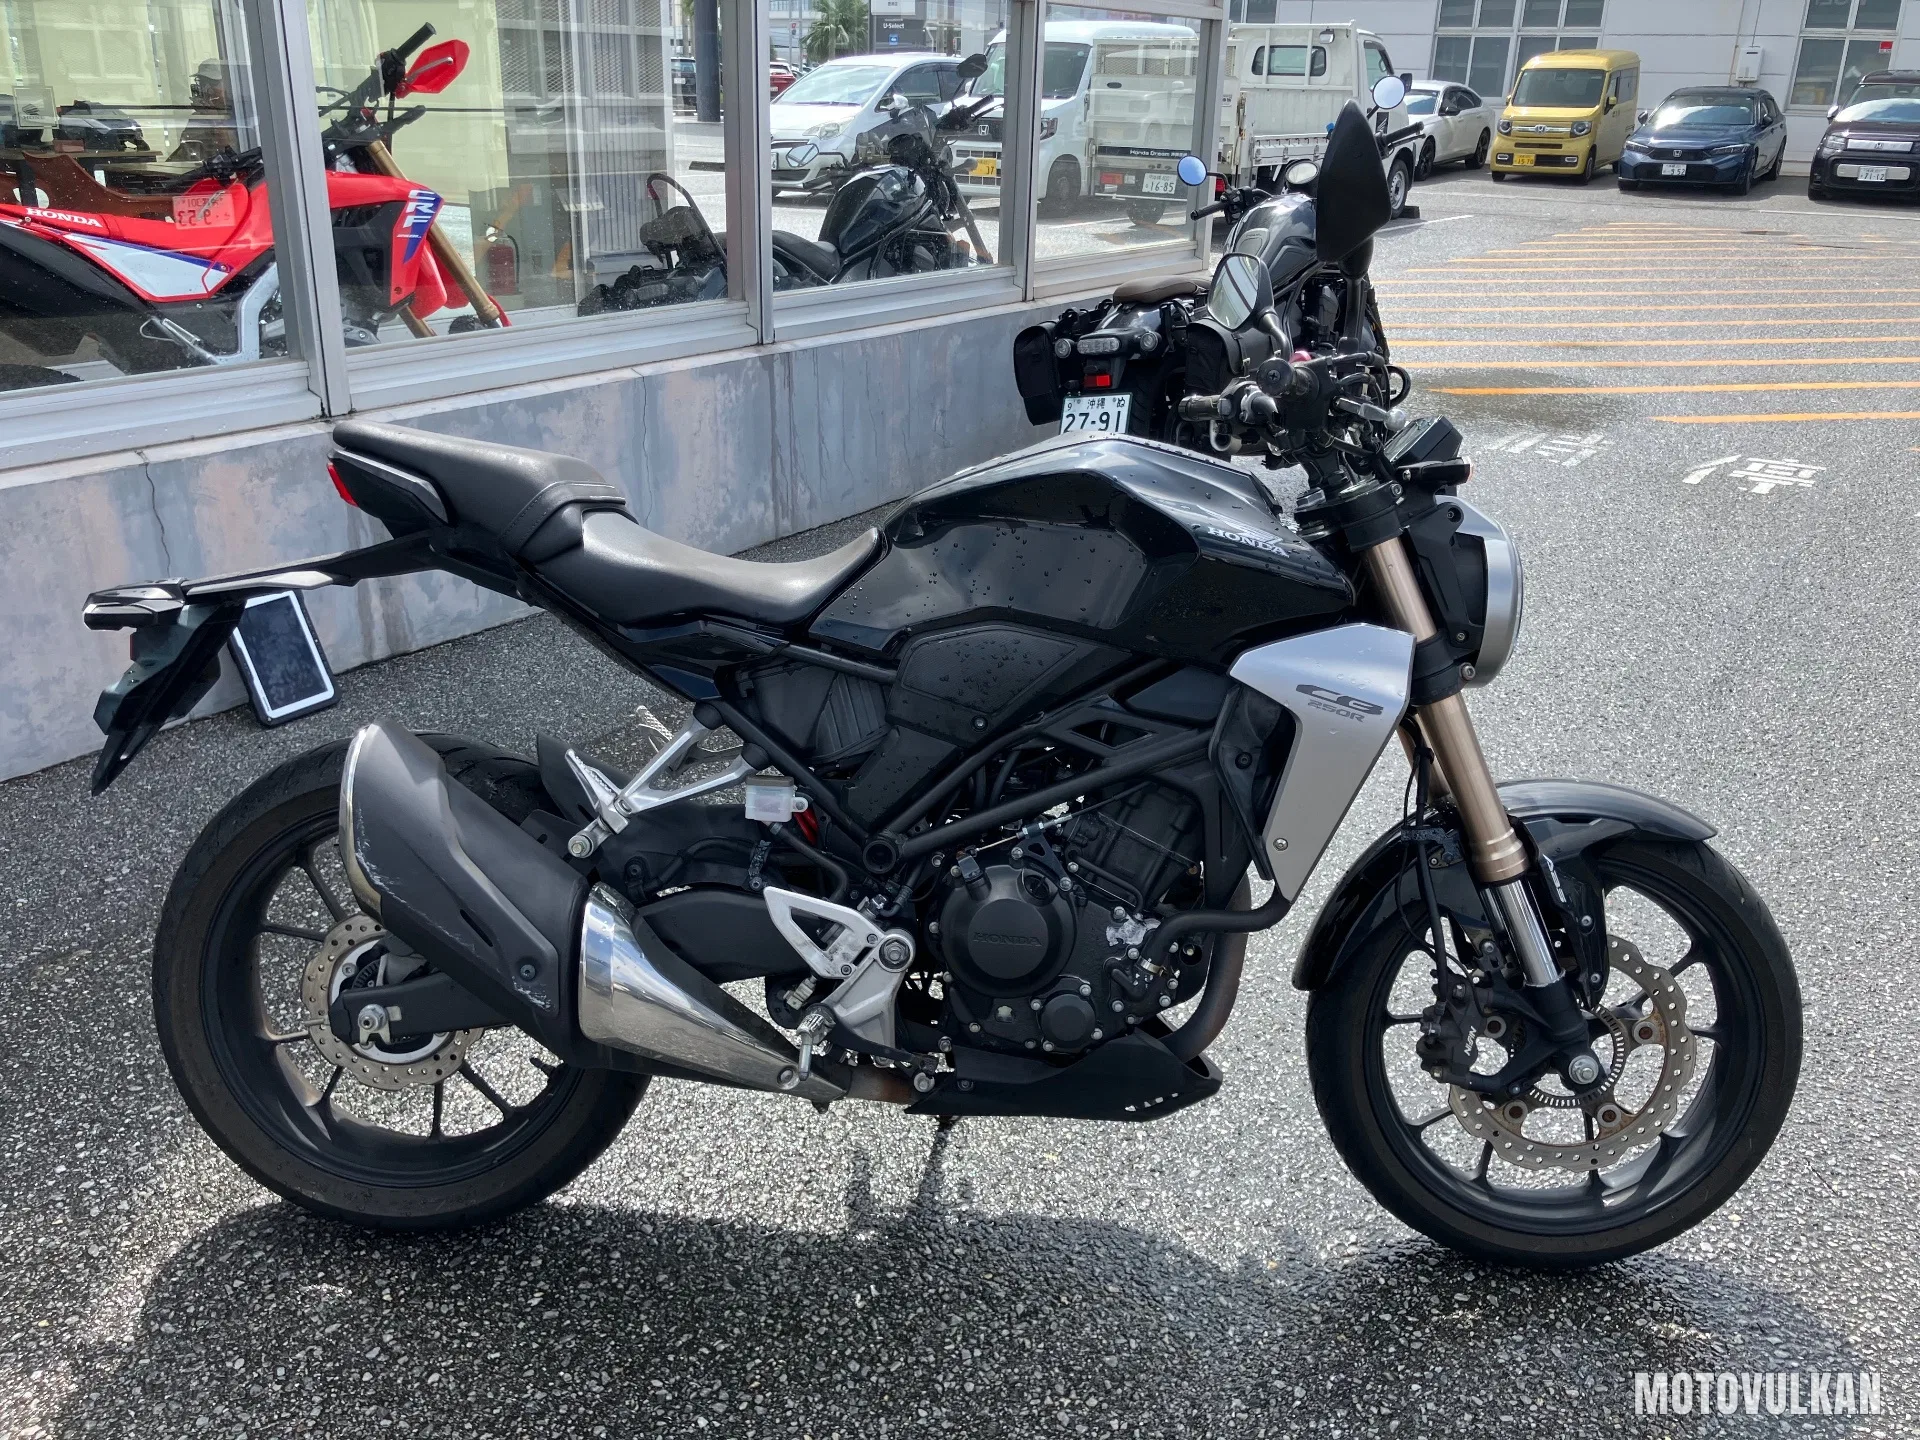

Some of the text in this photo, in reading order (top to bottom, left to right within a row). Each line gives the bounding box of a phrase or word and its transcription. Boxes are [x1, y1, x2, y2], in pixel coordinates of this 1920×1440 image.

[1150, 182, 1175, 192] 16-85
[25, 207, 103, 228] HONDA
[403, 189, 436, 229] CRF
[1087, 397, 1106, 410] 沖縄
[1063, 410, 1122, 433] 27-91
[1208, 526, 1290, 558] HONDA
[1295, 684, 1384, 716] CB
[1307, 699, 1366, 723] 250R
[1542, 853, 1567, 903] ABS
[973, 931, 1043, 947] HONDA
